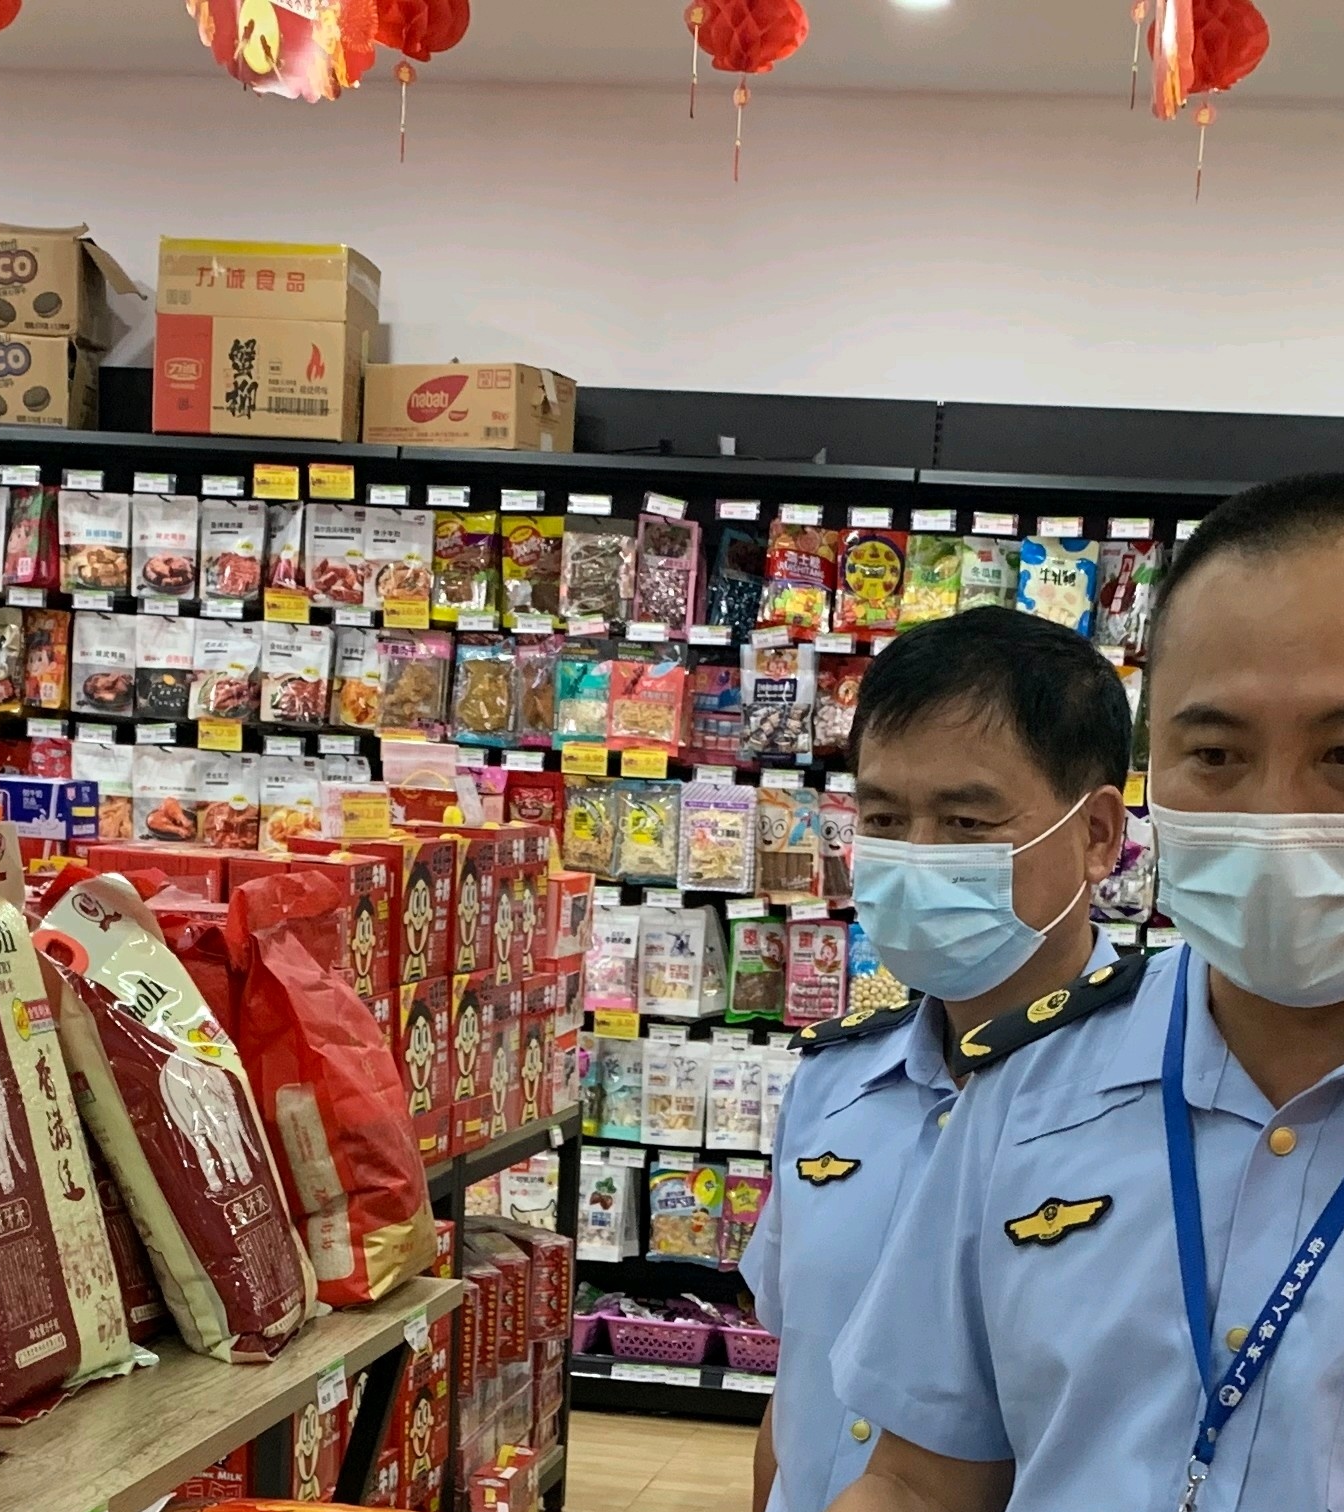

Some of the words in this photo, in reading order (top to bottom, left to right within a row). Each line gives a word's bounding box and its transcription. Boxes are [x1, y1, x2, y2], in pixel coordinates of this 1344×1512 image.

[1233, 1236, 1326, 1386] 广东省人民政府
[217, 1470, 244, 1482] MILK
